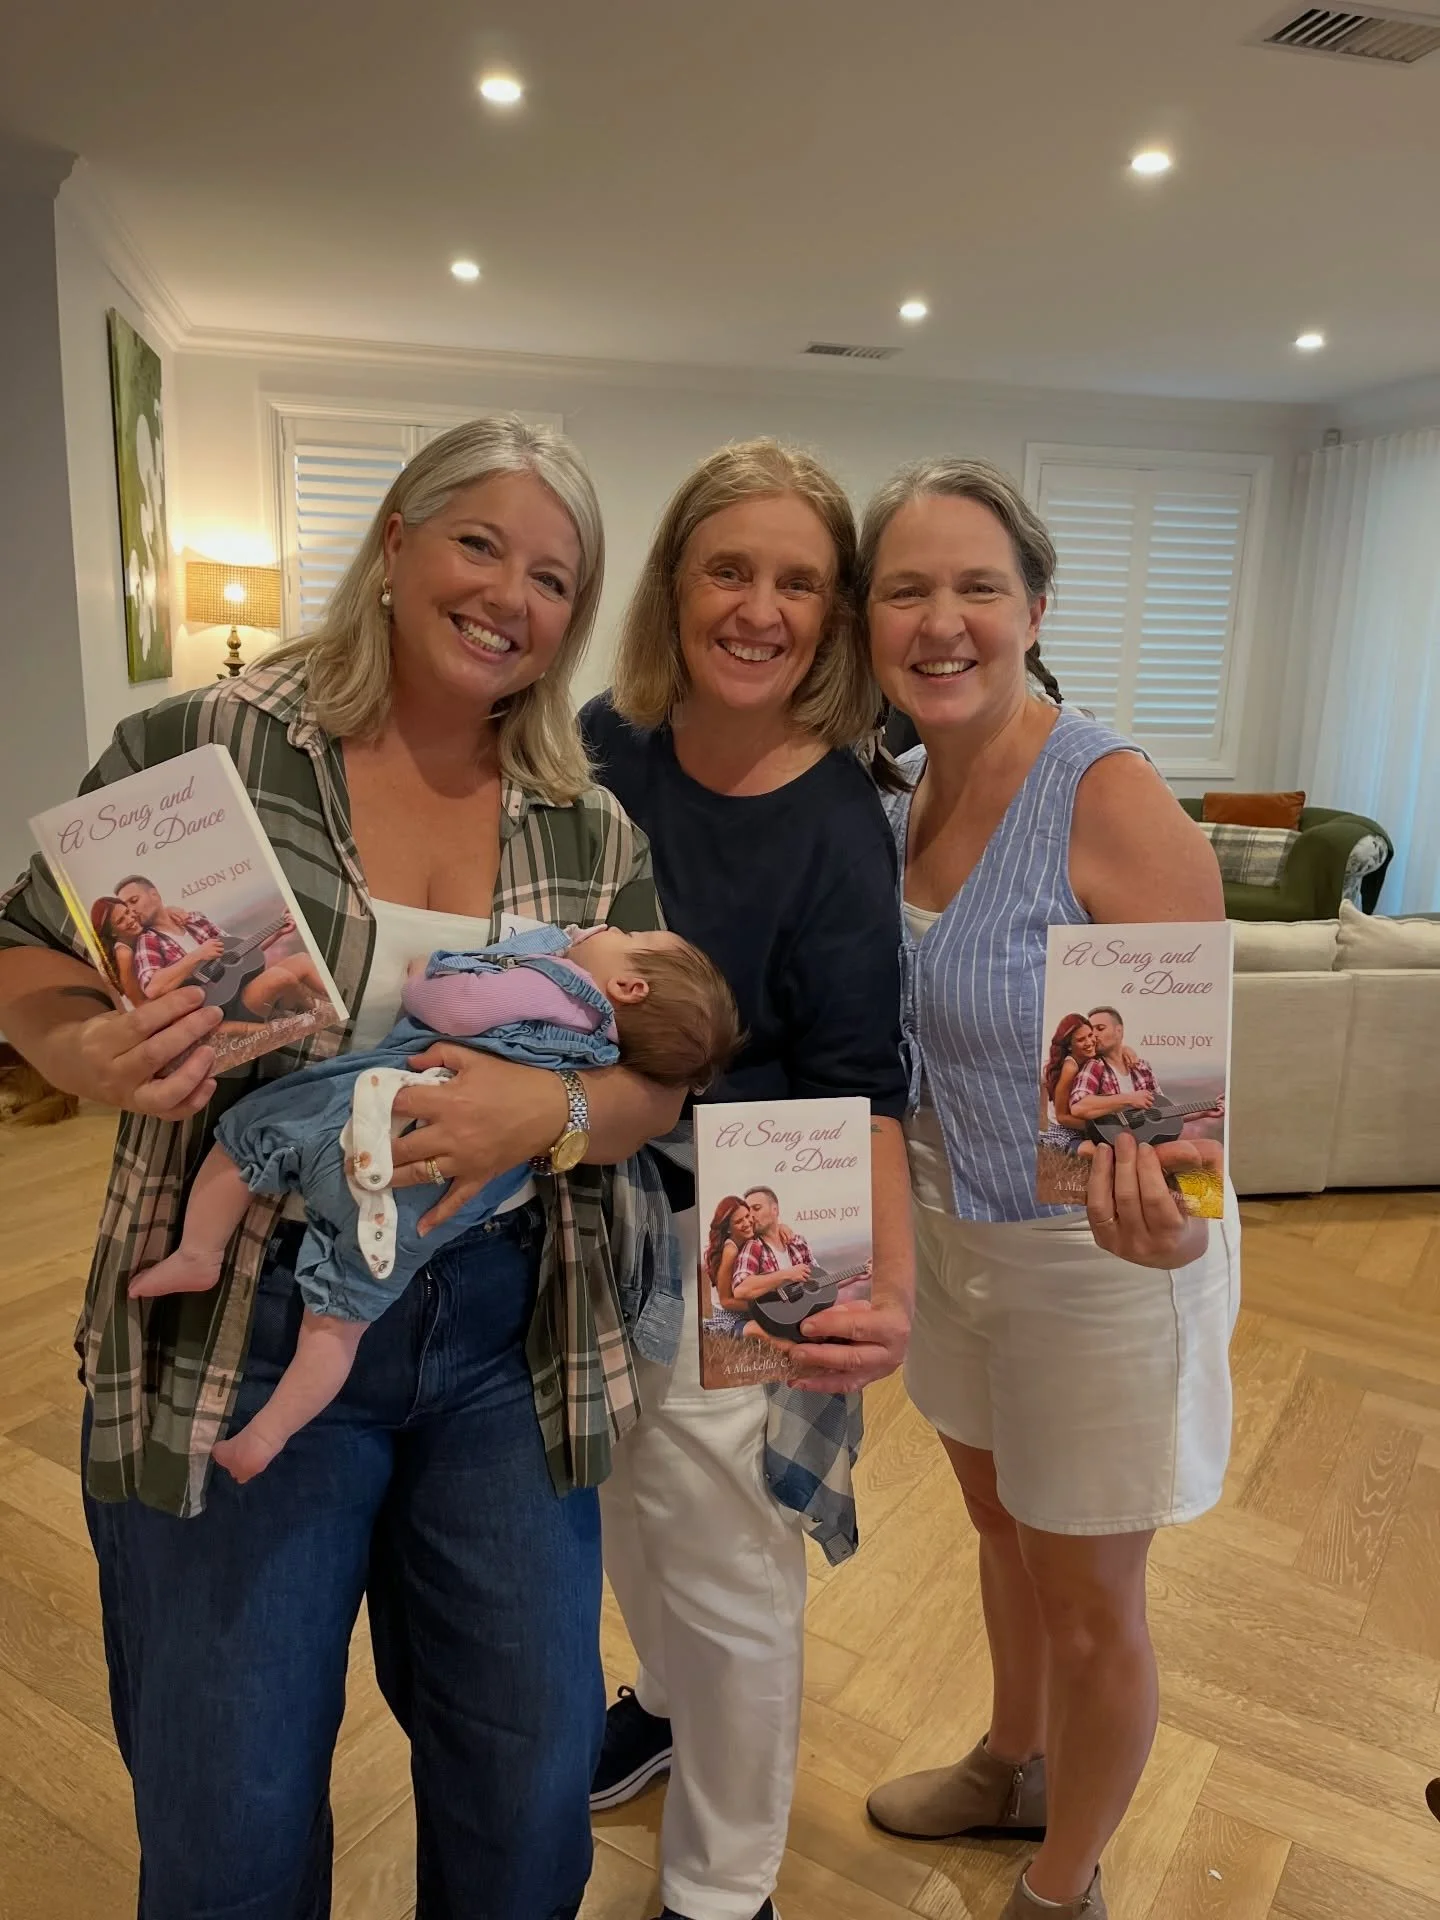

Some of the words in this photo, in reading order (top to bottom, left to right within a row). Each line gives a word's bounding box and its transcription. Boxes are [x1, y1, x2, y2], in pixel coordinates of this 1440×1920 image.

[57, 819, 84, 855] A
[89, 804, 154, 841] Song
[160, 776, 195, 810] and
[135, 841, 149, 857] a
[154, 807, 226, 851] Dance
[181, 868, 226, 899] ALISON
[229, 859, 253, 882] JOY
[1061, 941, 1093, 967] A
[1092, 939, 1154, 972] Song
[1159, 944, 1202, 964] and
[1121, 981, 1135, 995] a
[1140, 970, 1213, 995] Dance
[1140, 1035, 1186, 1047] ALISON
[1189, 1036, 1214, 1050] JOY
[715, 1122, 743, 1149] A
[744, 1119, 804, 1150] Song
[808, 1120, 847, 1141] and
[774, 1160, 786, 1173] a
[791, 1148, 858, 1173] Dance
[795, 1208, 837, 1222] ALISON
[840, 1206, 861, 1221] JOY
